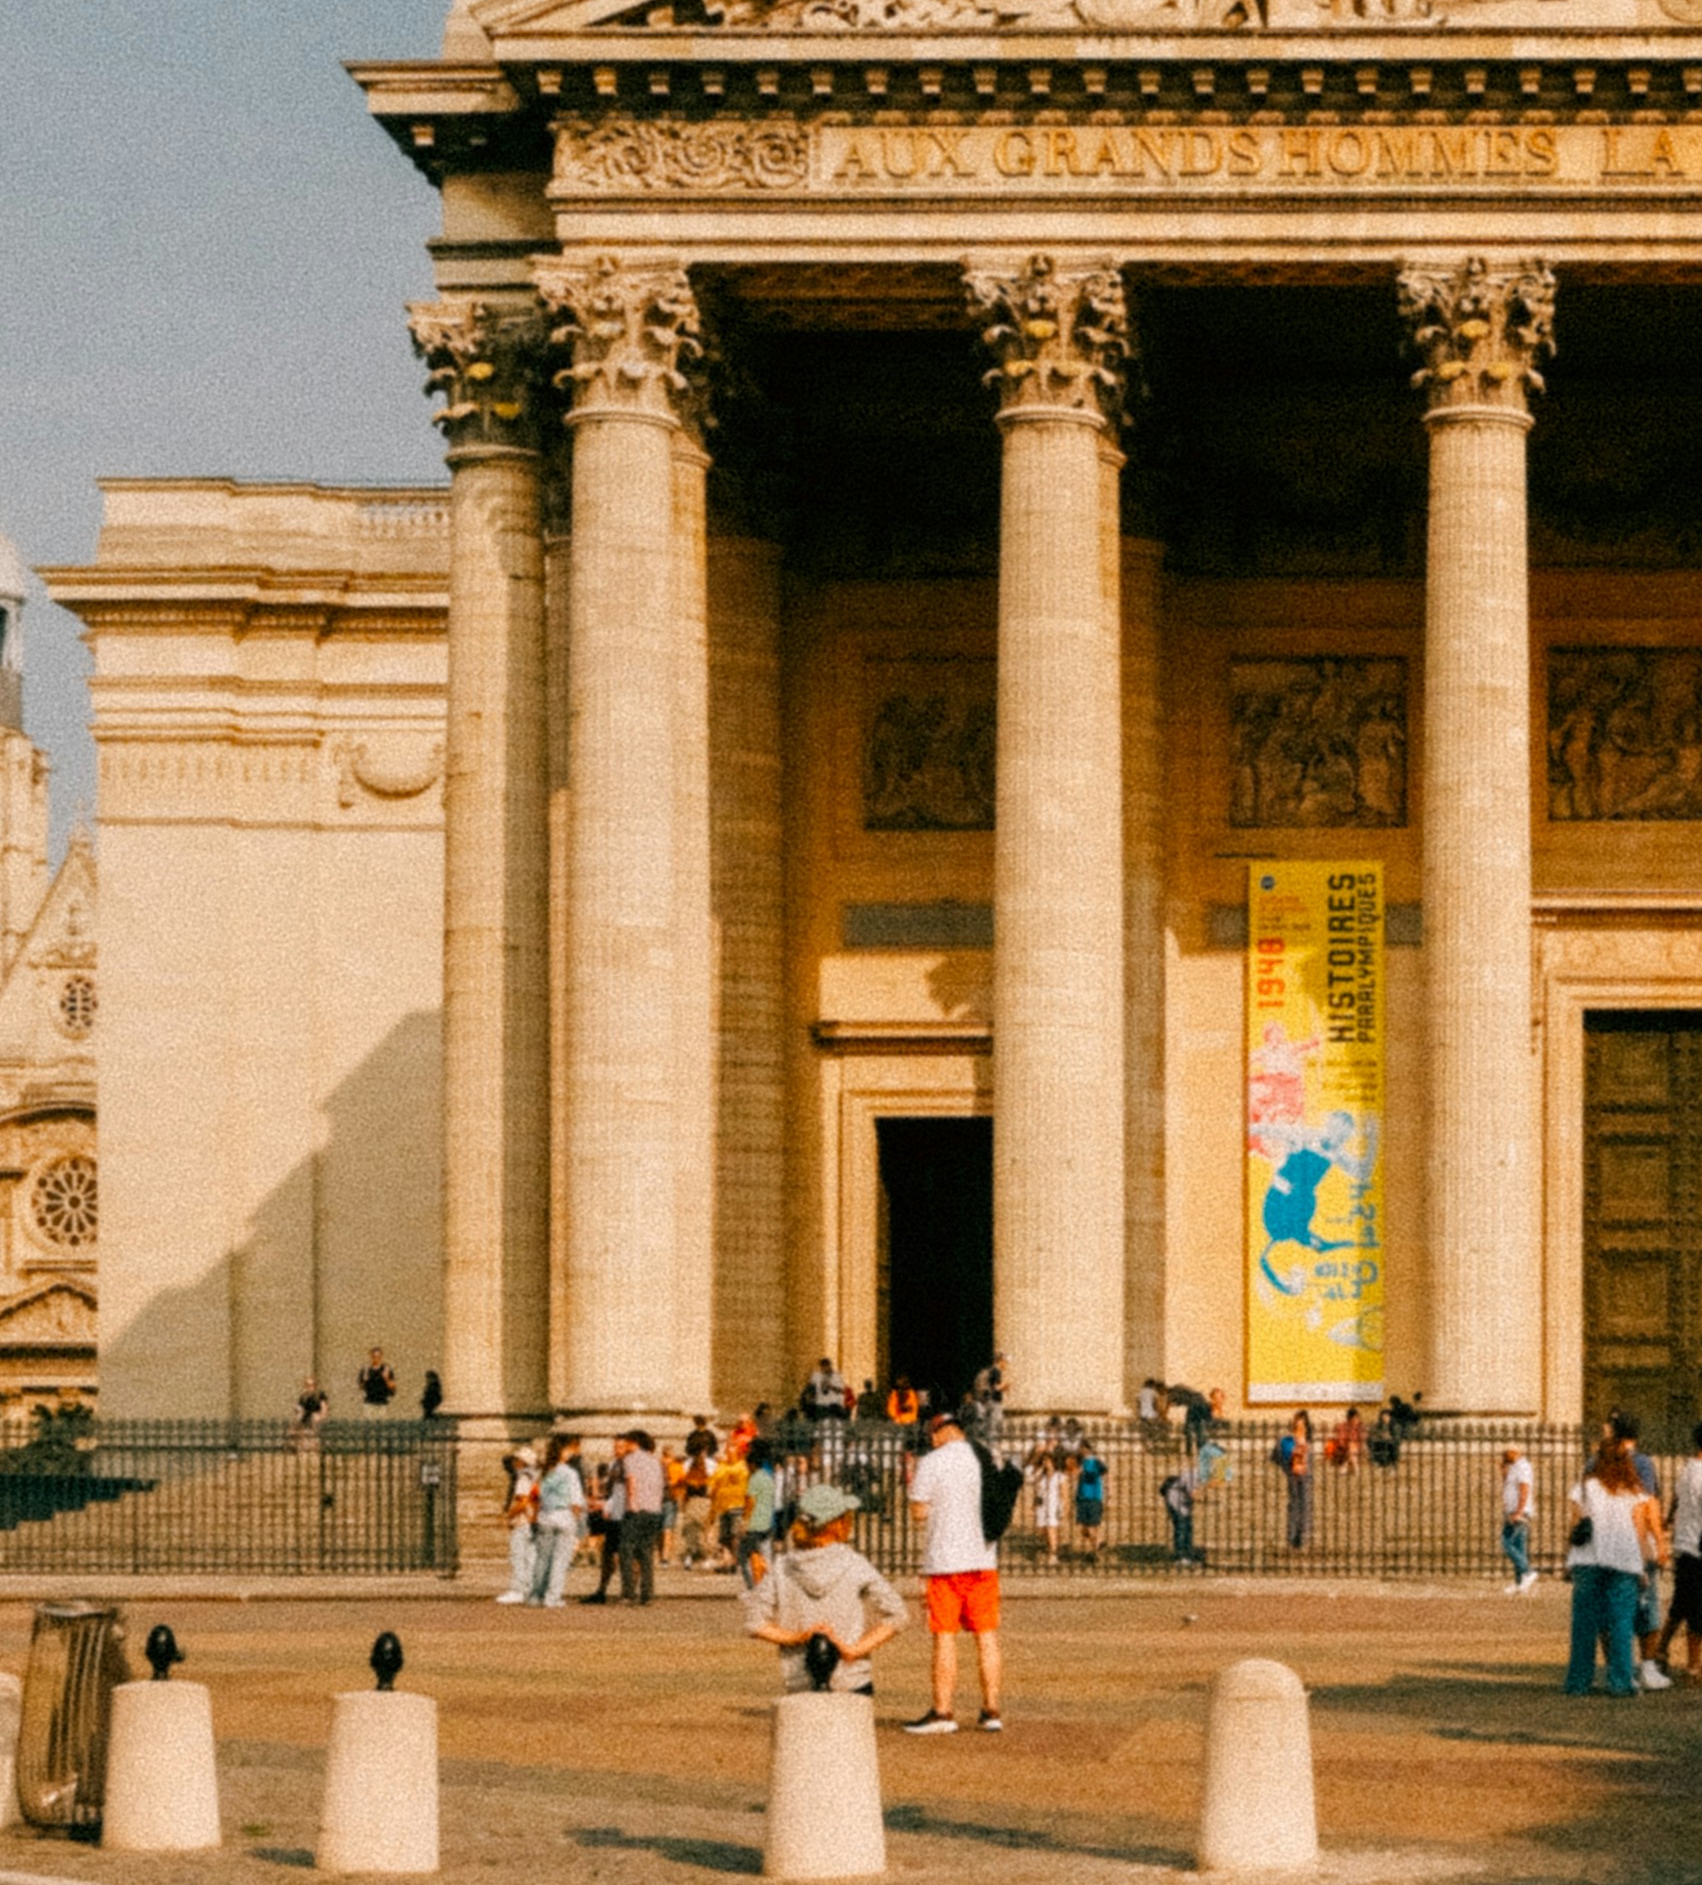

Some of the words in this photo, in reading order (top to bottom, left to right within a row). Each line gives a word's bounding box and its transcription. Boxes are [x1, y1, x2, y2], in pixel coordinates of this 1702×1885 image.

[833, 129, 976, 178] AUX
[992, 129, 1260, 178] GRANDS
[1276, 128, 1557, 178] HOMMES
[1600, 128, 1687, 178] LA
[1256, 937, 1286, 1010] 1948
[1327, 873, 1356, 1044] HISTOIRES
[1357, 873, 1380, 1044] PARALYMPIQUES
